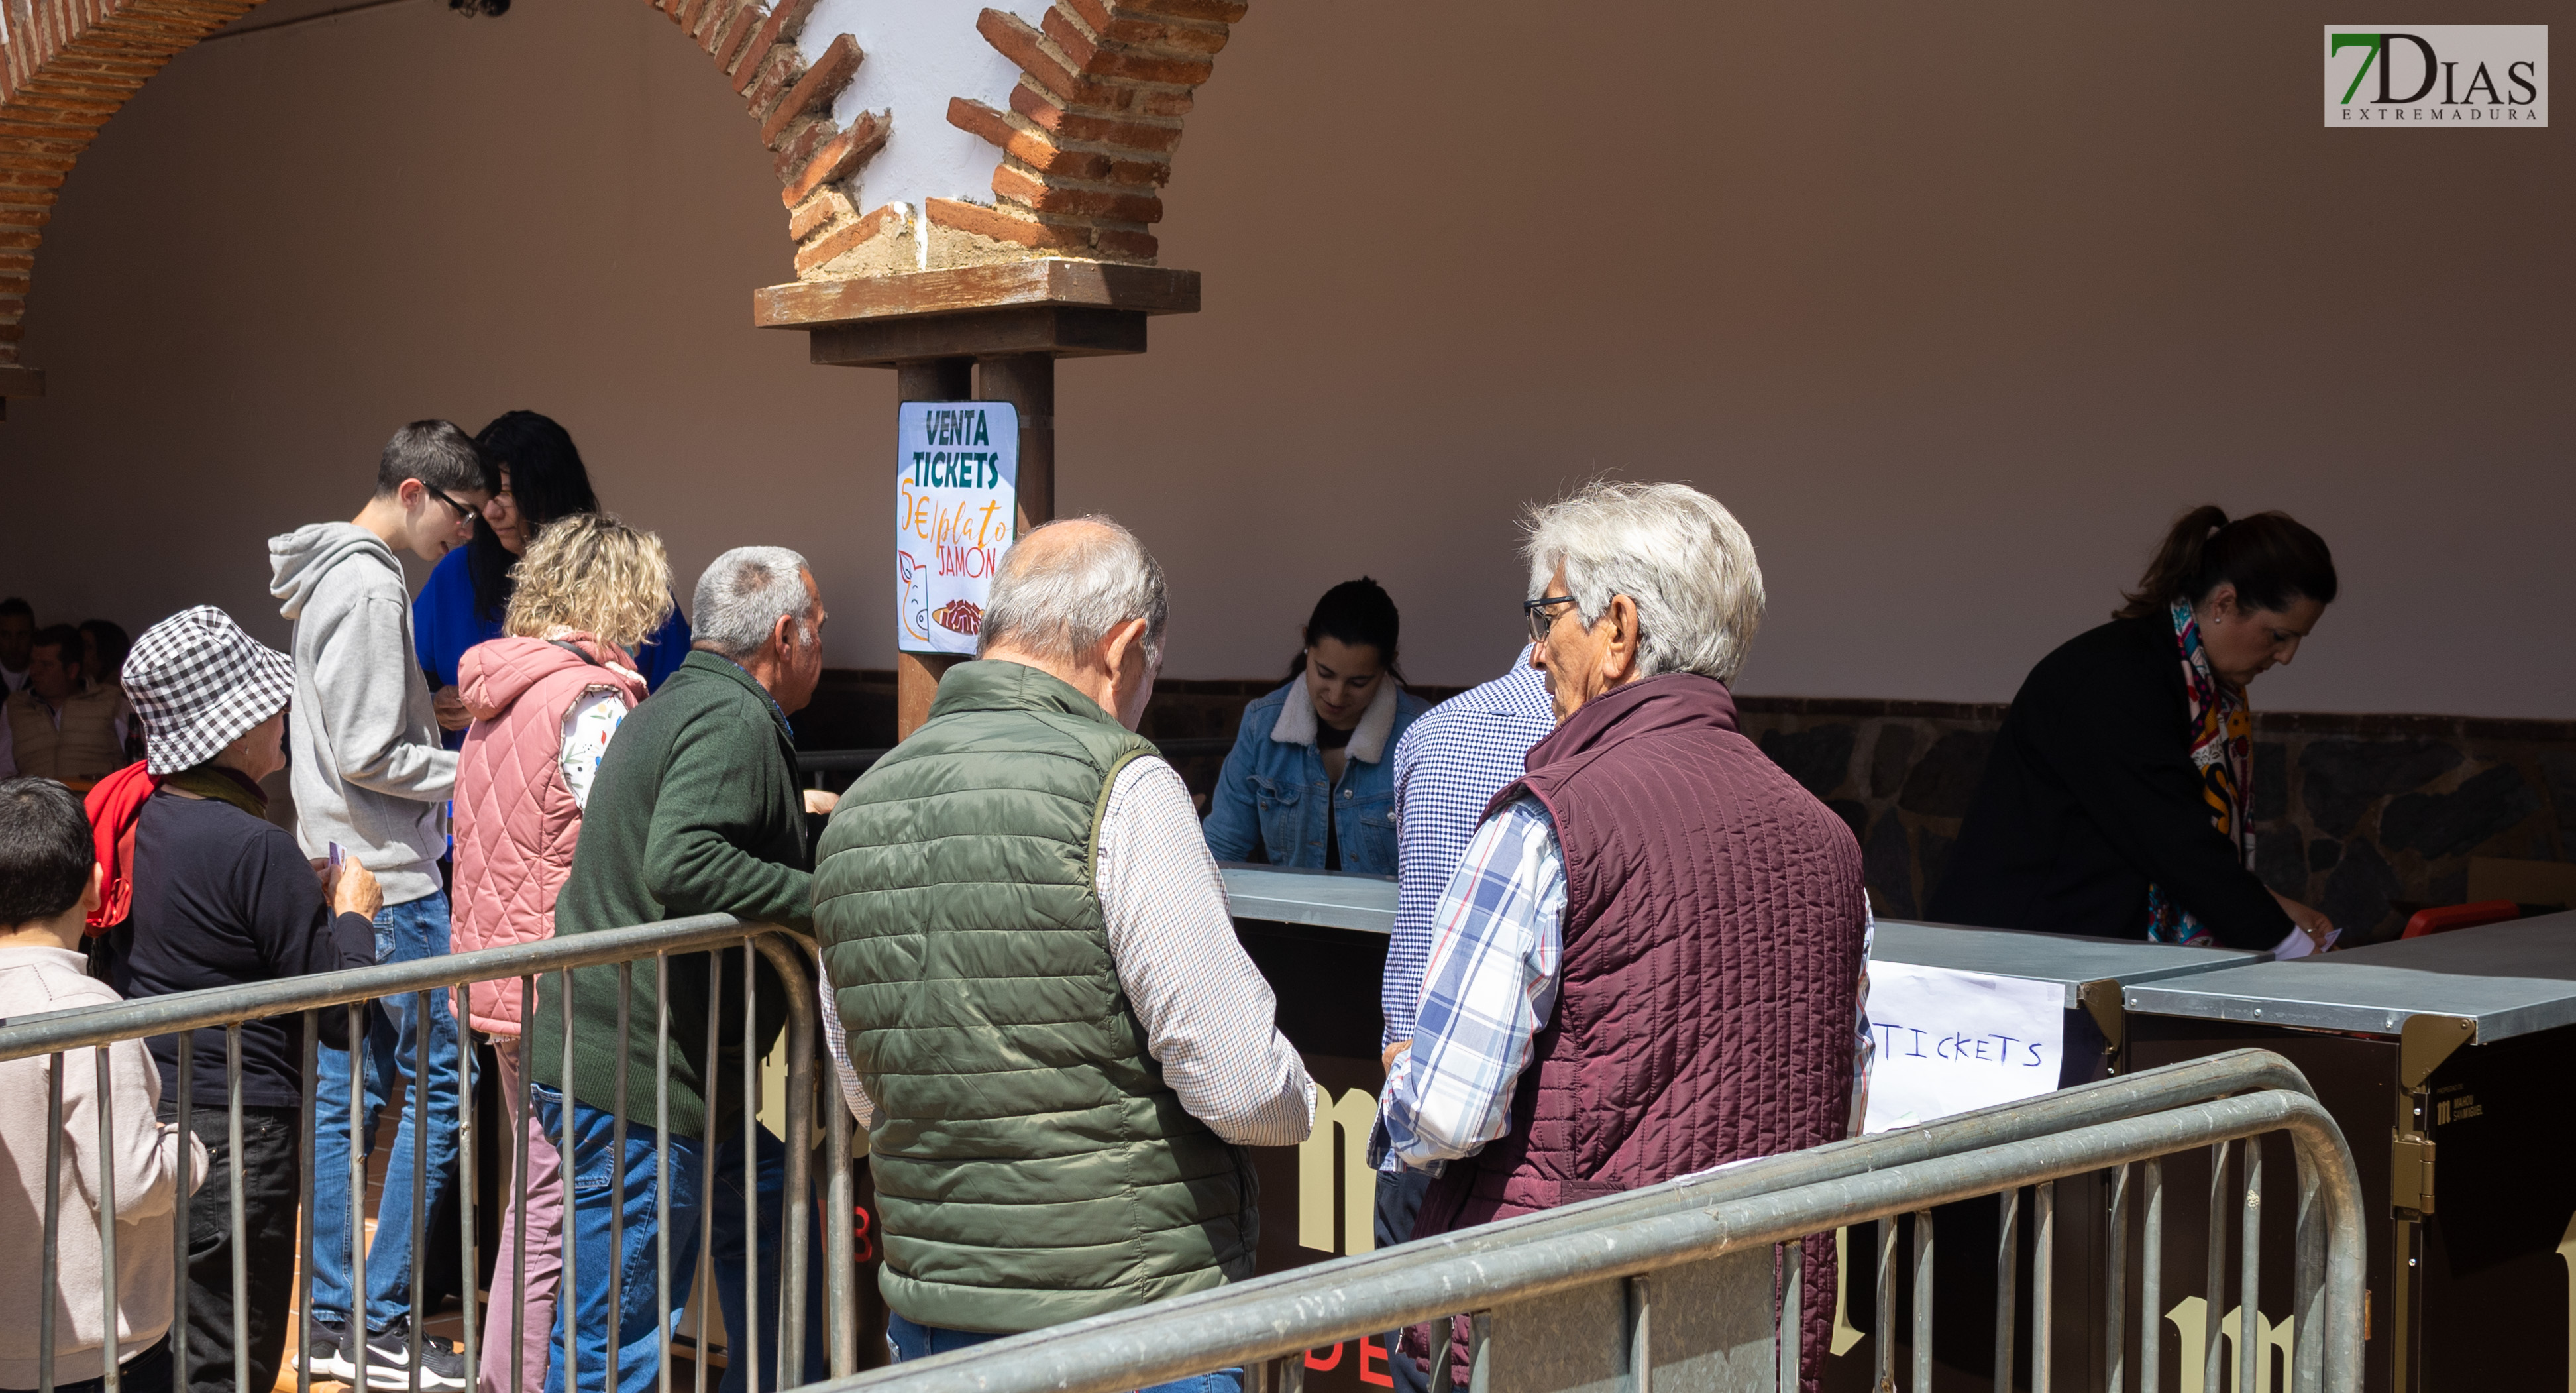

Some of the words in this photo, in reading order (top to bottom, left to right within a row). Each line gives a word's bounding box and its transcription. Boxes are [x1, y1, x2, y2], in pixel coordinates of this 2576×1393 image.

[926, 410, 989, 446] VENTA
[912, 451, 999, 490] TICKETS
[1872, 1022, 2043, 1067] TICKETS
